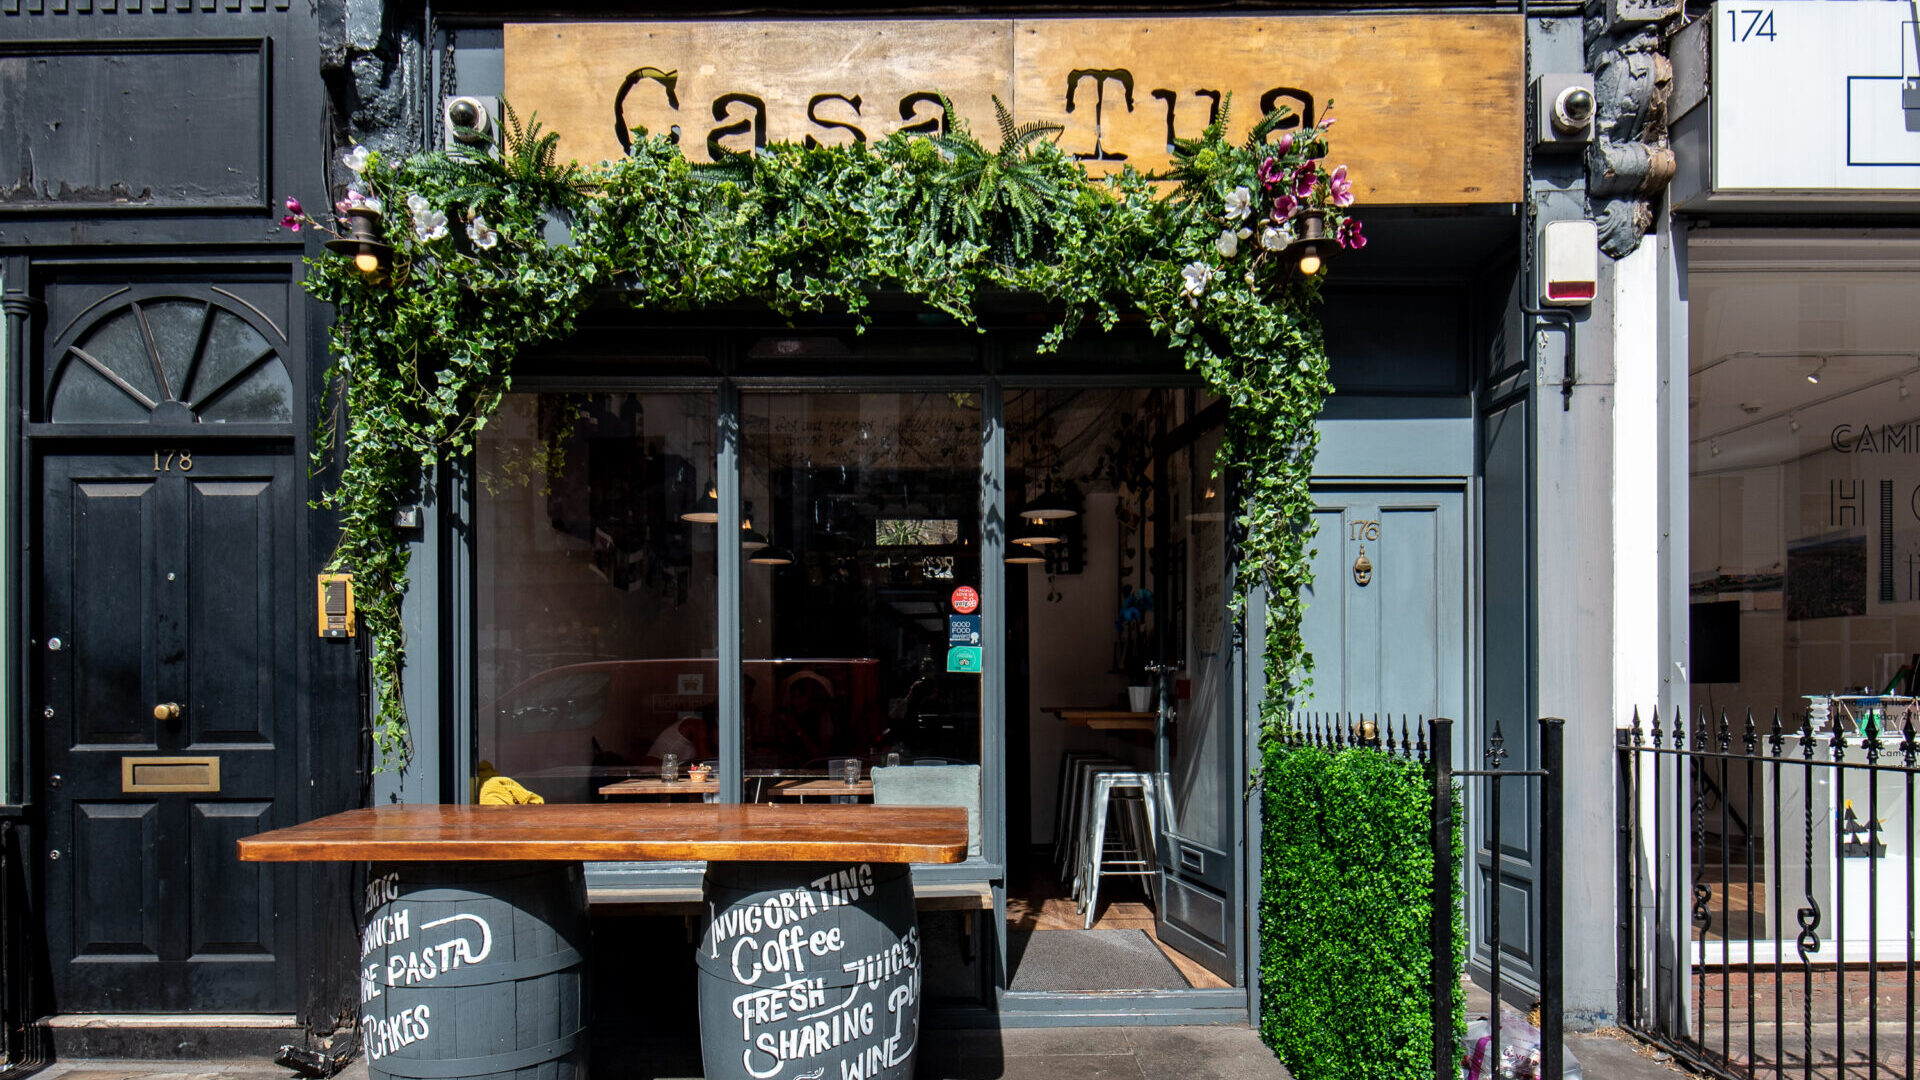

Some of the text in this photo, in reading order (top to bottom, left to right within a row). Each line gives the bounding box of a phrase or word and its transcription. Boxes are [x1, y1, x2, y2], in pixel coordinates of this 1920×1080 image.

[1727, 9, 1777, 42] 174
[613, 66, 1330, 162] Casa Tua
[152, 449, 193, 471] 178
[1350, 520, 1380, 541] 176
[360, 909, 410, 962] RUNCH
[709, 863, 875, 959] INVIGORATING
[387, 913, 492, 988] PASTA
[731, 925, 844, 985] Coffee
[732, 973, 825, 1041] FRESH
[743, 1002, 874, 1078] SHARING
[841, 1018, 918, 1080] WINE
